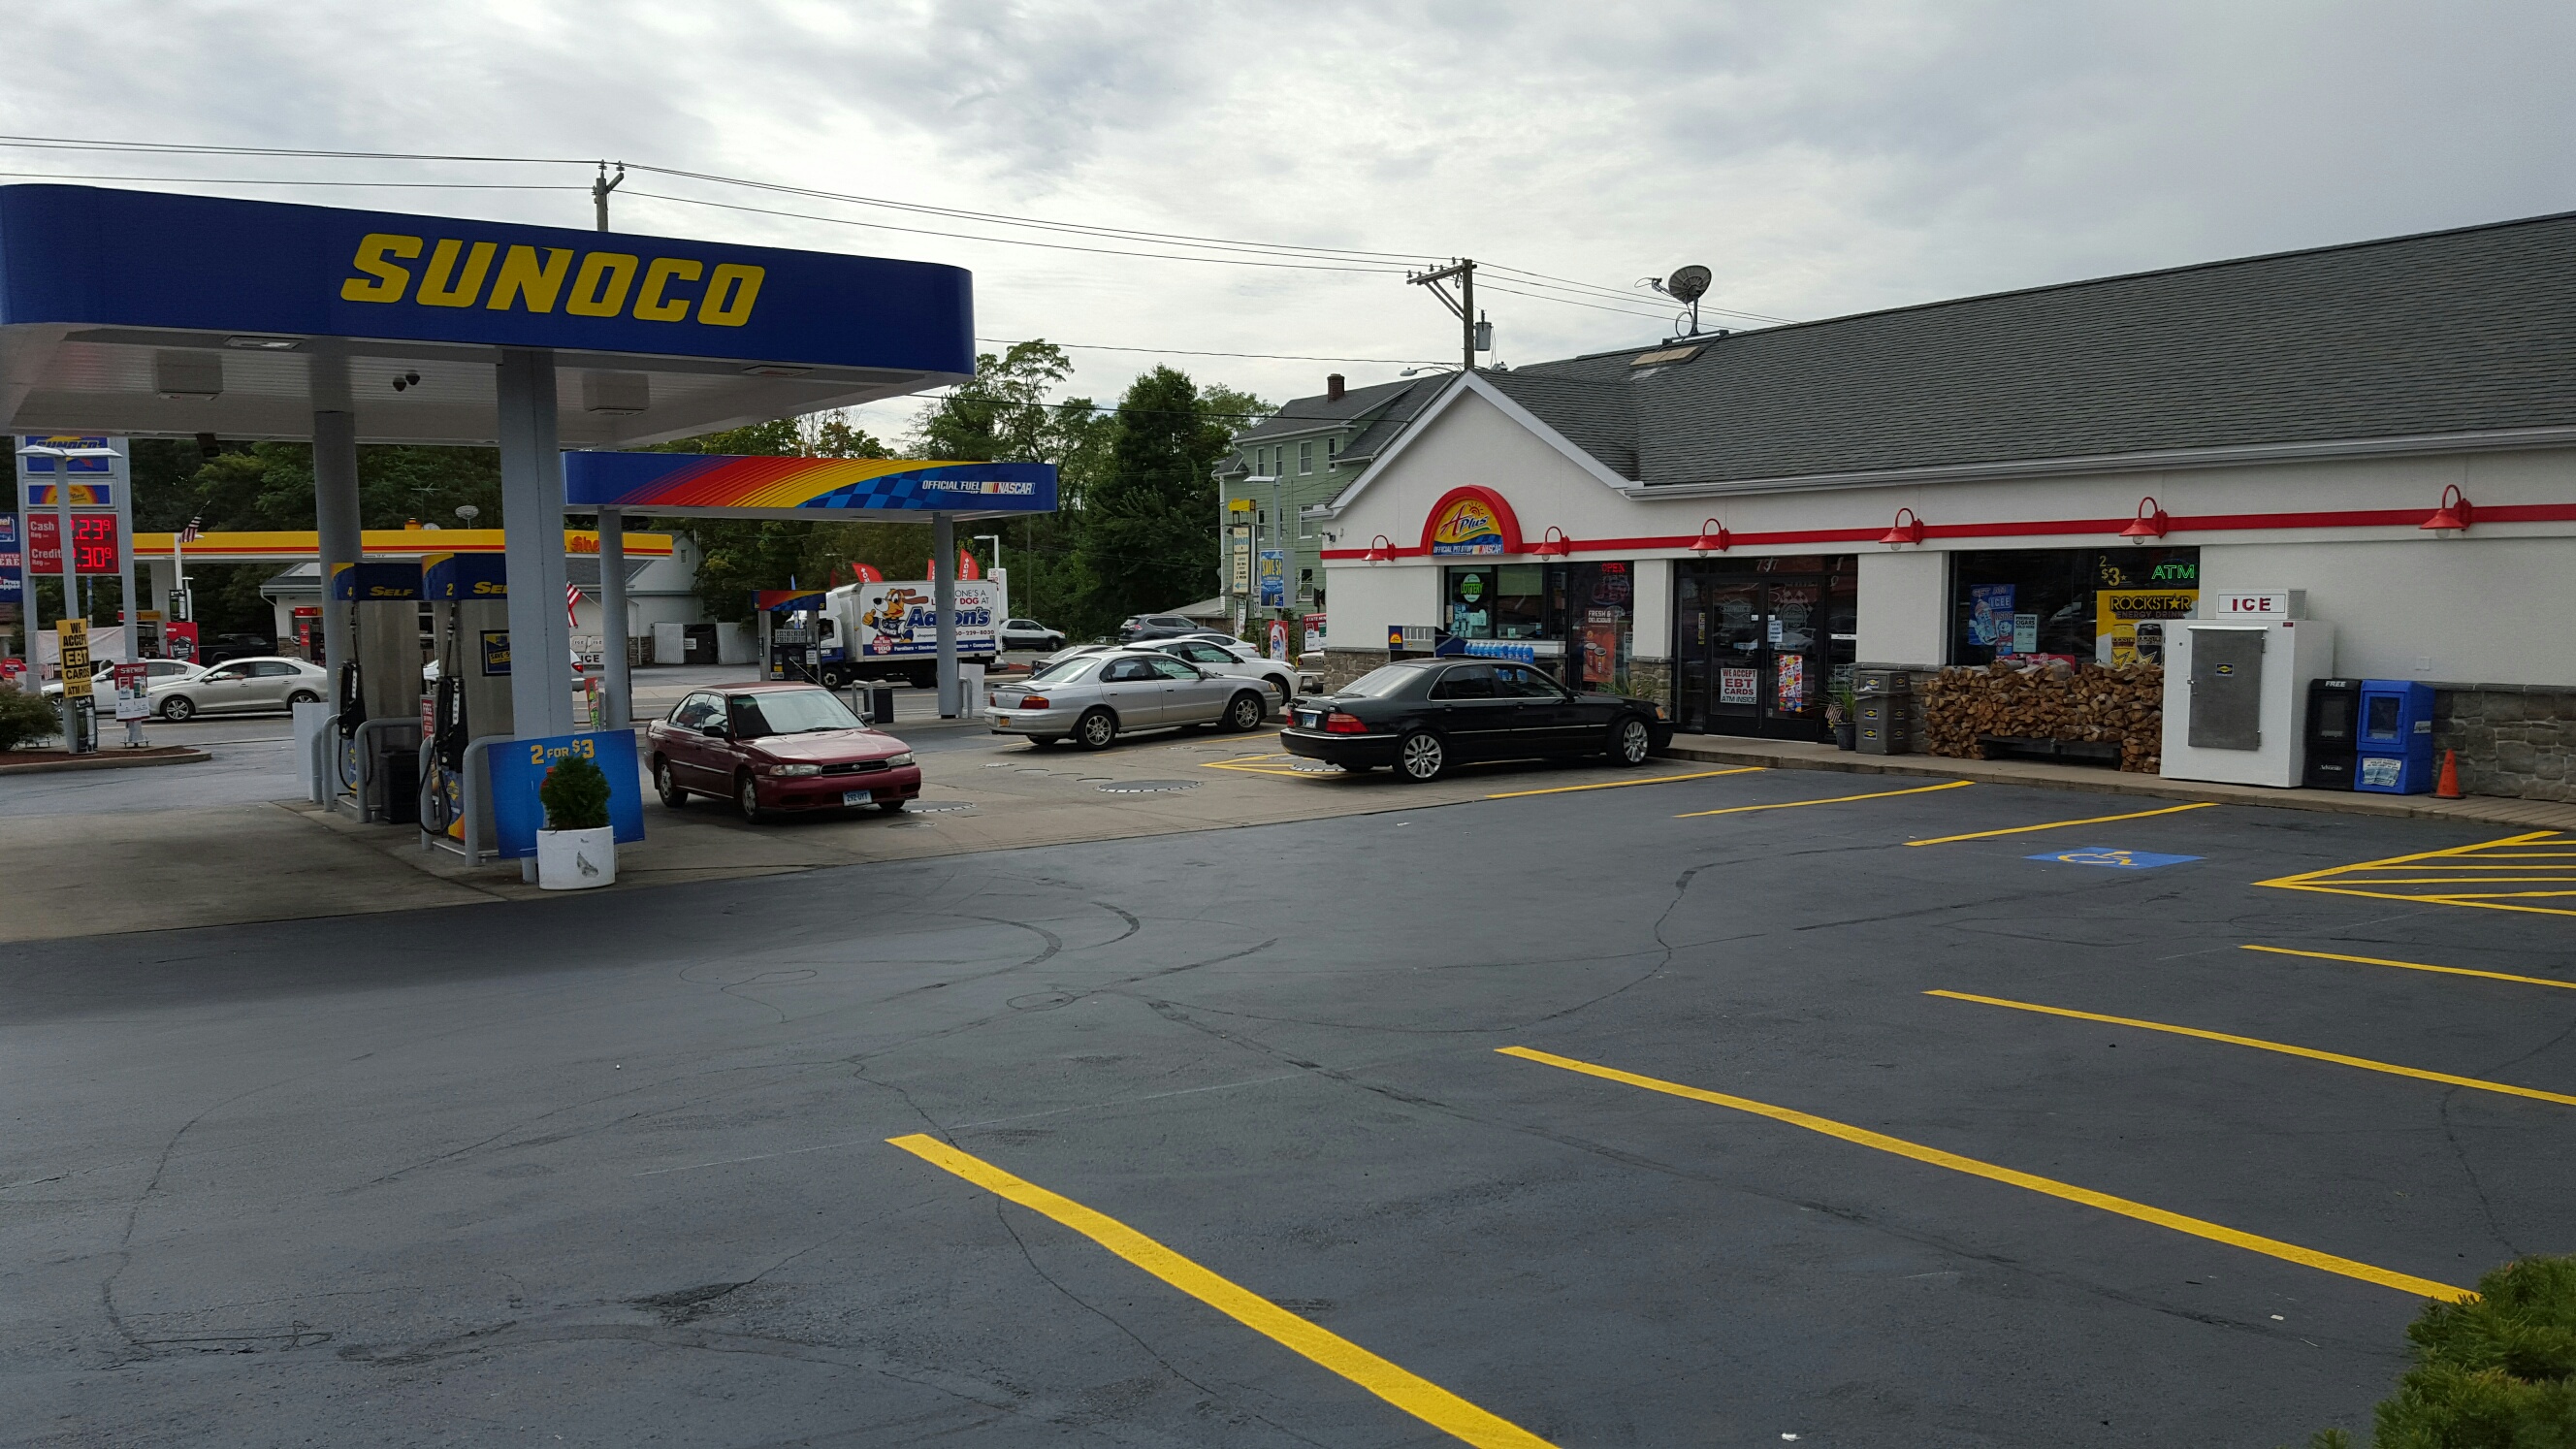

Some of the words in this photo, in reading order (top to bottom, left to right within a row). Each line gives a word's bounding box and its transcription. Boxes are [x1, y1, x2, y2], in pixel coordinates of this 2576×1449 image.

[339, 232, 766, 327] SUNOCO
[922, 480, 958, 490] OFFICIAL
[960, 481, 980, 490] FUEL
[997, 482, 1034, 495] NASCAR
[30, 521, 54, 531] Cash
[70, 519, 111, 540] .239
[1433, 545, 1453, 554] OFFICIAL
[1481, 544, 1502, 554] NASCAR
[31, 548, 62, 559] Credit
[73, 547, 112, 567] .309
[2099, 556, 2107, 567] 2
[1262, 559, 1274, 577] SAVE
[1601, 564, 1626, 573] OPEN
[2151, 564, 2195, 579] ATM
[2101, 567, 2120, 586] $3
[346, 586, 353, 597] 4
[370, 586, 414, 596] SELF
[446, 583, 455, 596] 2
[1460, 582, 1485, 595] LOTTERY
[1989, 596, 2012, 608] ICEE
[2233, 597, 2271, 611] ICE
[905, 606, 991, 628] Aaon's
[70, 622, 81, 634] WE
[63, 634, 87, 647] ACCEPT
[65, 650, 88, 666] EBT
[581, 654, 600, 663] ICE
[66, 667, 89, 680] CARDS
[1732, 669, 1755, 678] ACCEPT
[1724, 678, 1754, 688] EBT
[68, 685, 80, 695] ATM
[531, 744, 545, 765] 2
[546, 746, 569, 759] FOR
[571, 738, 595, 759] $3
